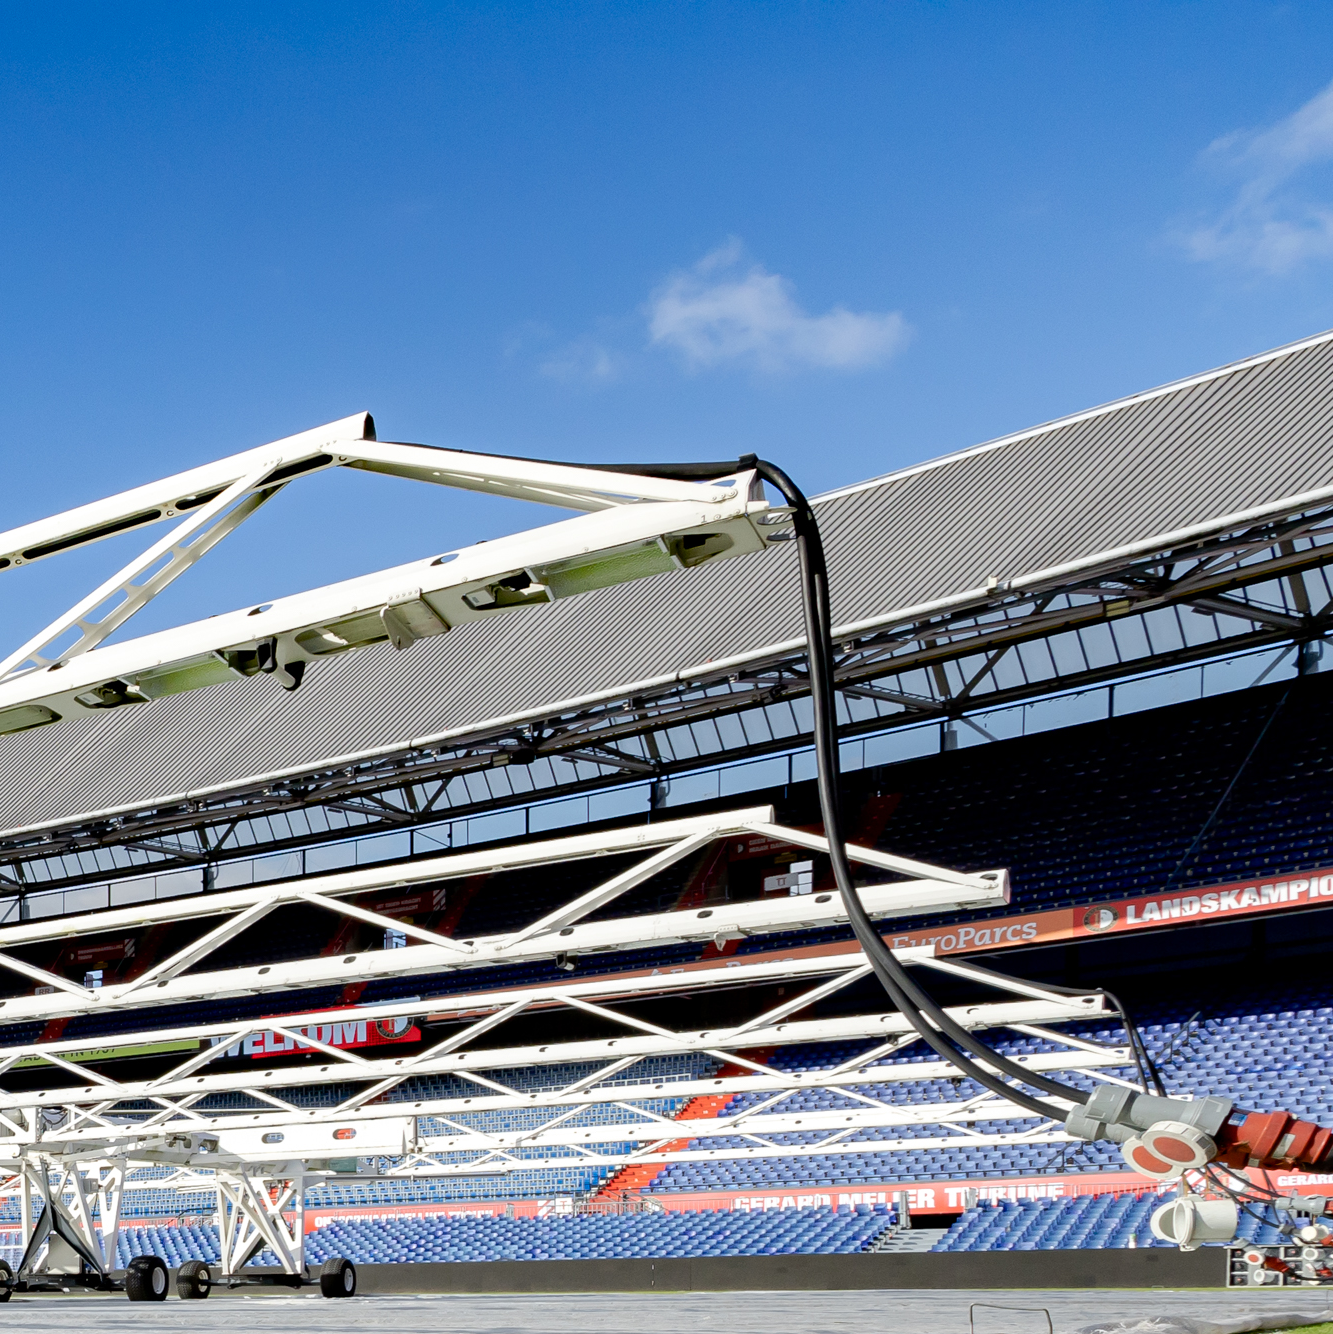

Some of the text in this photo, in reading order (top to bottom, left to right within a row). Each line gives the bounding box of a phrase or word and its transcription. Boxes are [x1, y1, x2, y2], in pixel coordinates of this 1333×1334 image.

[210, 1020, 367, 1058] WELKOM
[1277, 1173, 1333, 1187] GERAR
[944, 1183, 1065, 1207] TIBUNE
